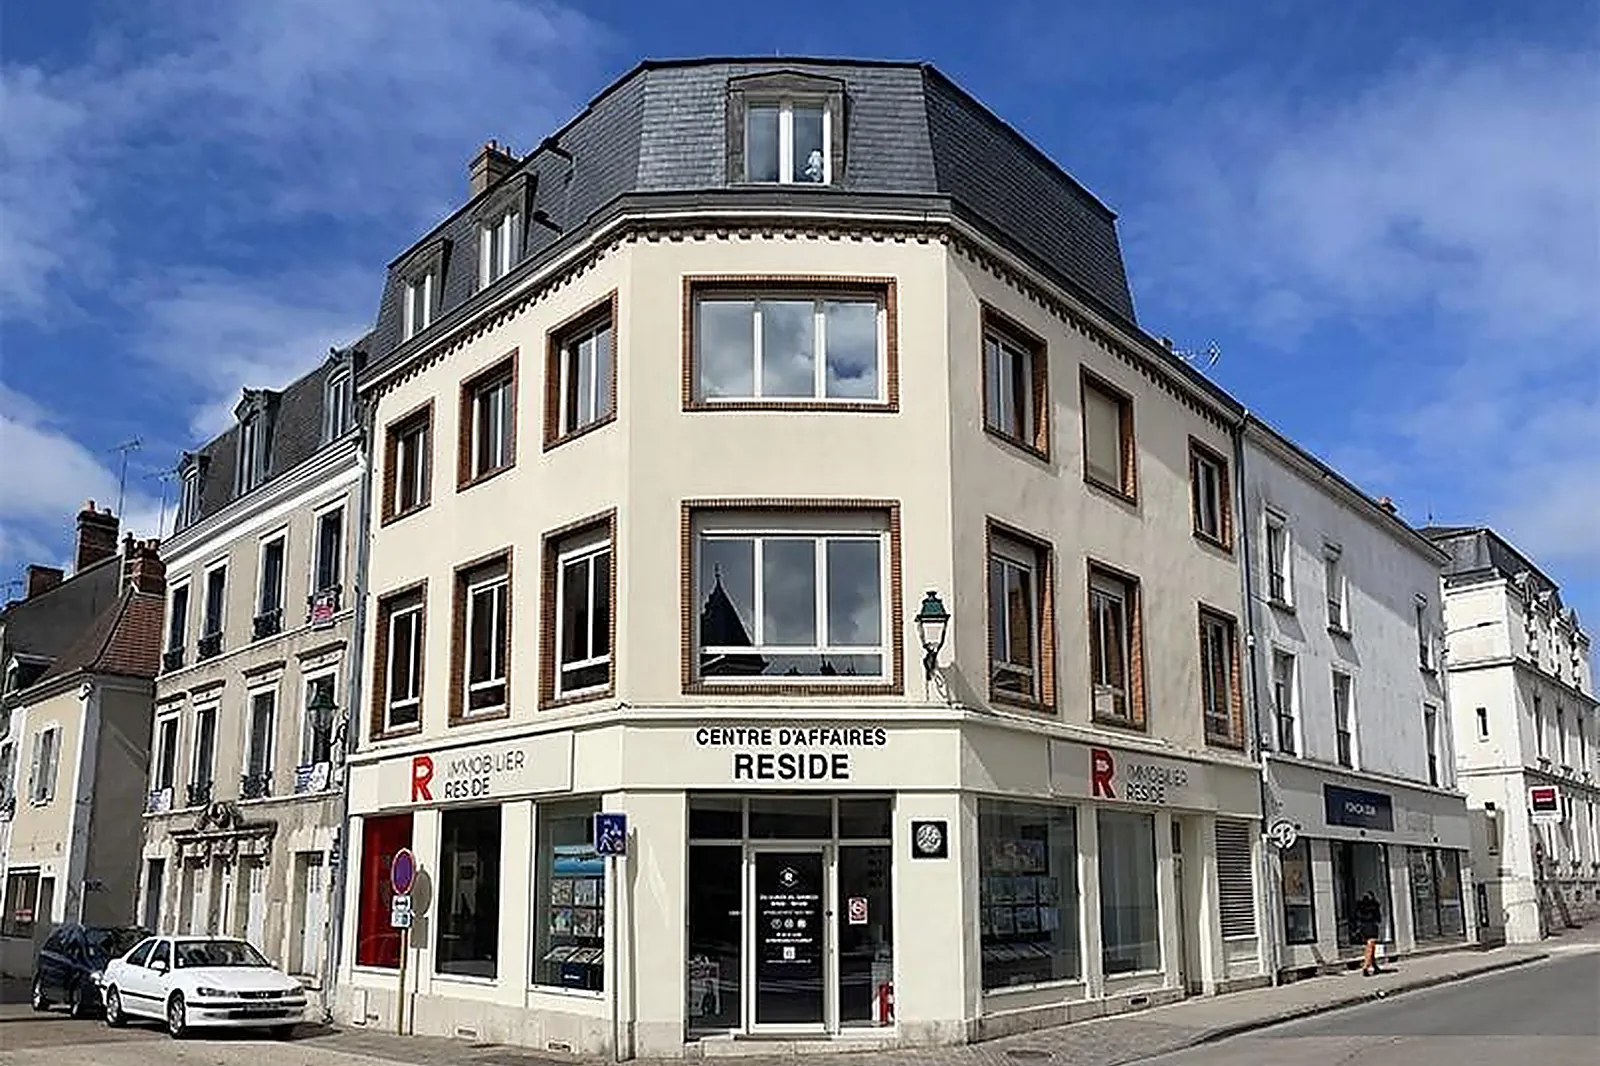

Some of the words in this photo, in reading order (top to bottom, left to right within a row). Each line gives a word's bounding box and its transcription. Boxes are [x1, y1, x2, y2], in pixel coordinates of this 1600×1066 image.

[696, 728, 773, 746] CENTRE
[779, 728, 887, 746] D'AFFAIRES
[447, 751, 525, 778] IMMOBLIER
[734, 752, 850, 780] RESIDE
[1091, 748, 1117, 800] R
[1126, 763, 1189, 787] IMMOBLIER
[411, 755, 434, 803] R
[444, 776, 491, 799] RESDE
[1126, 782, 1166, 804] RESDE
